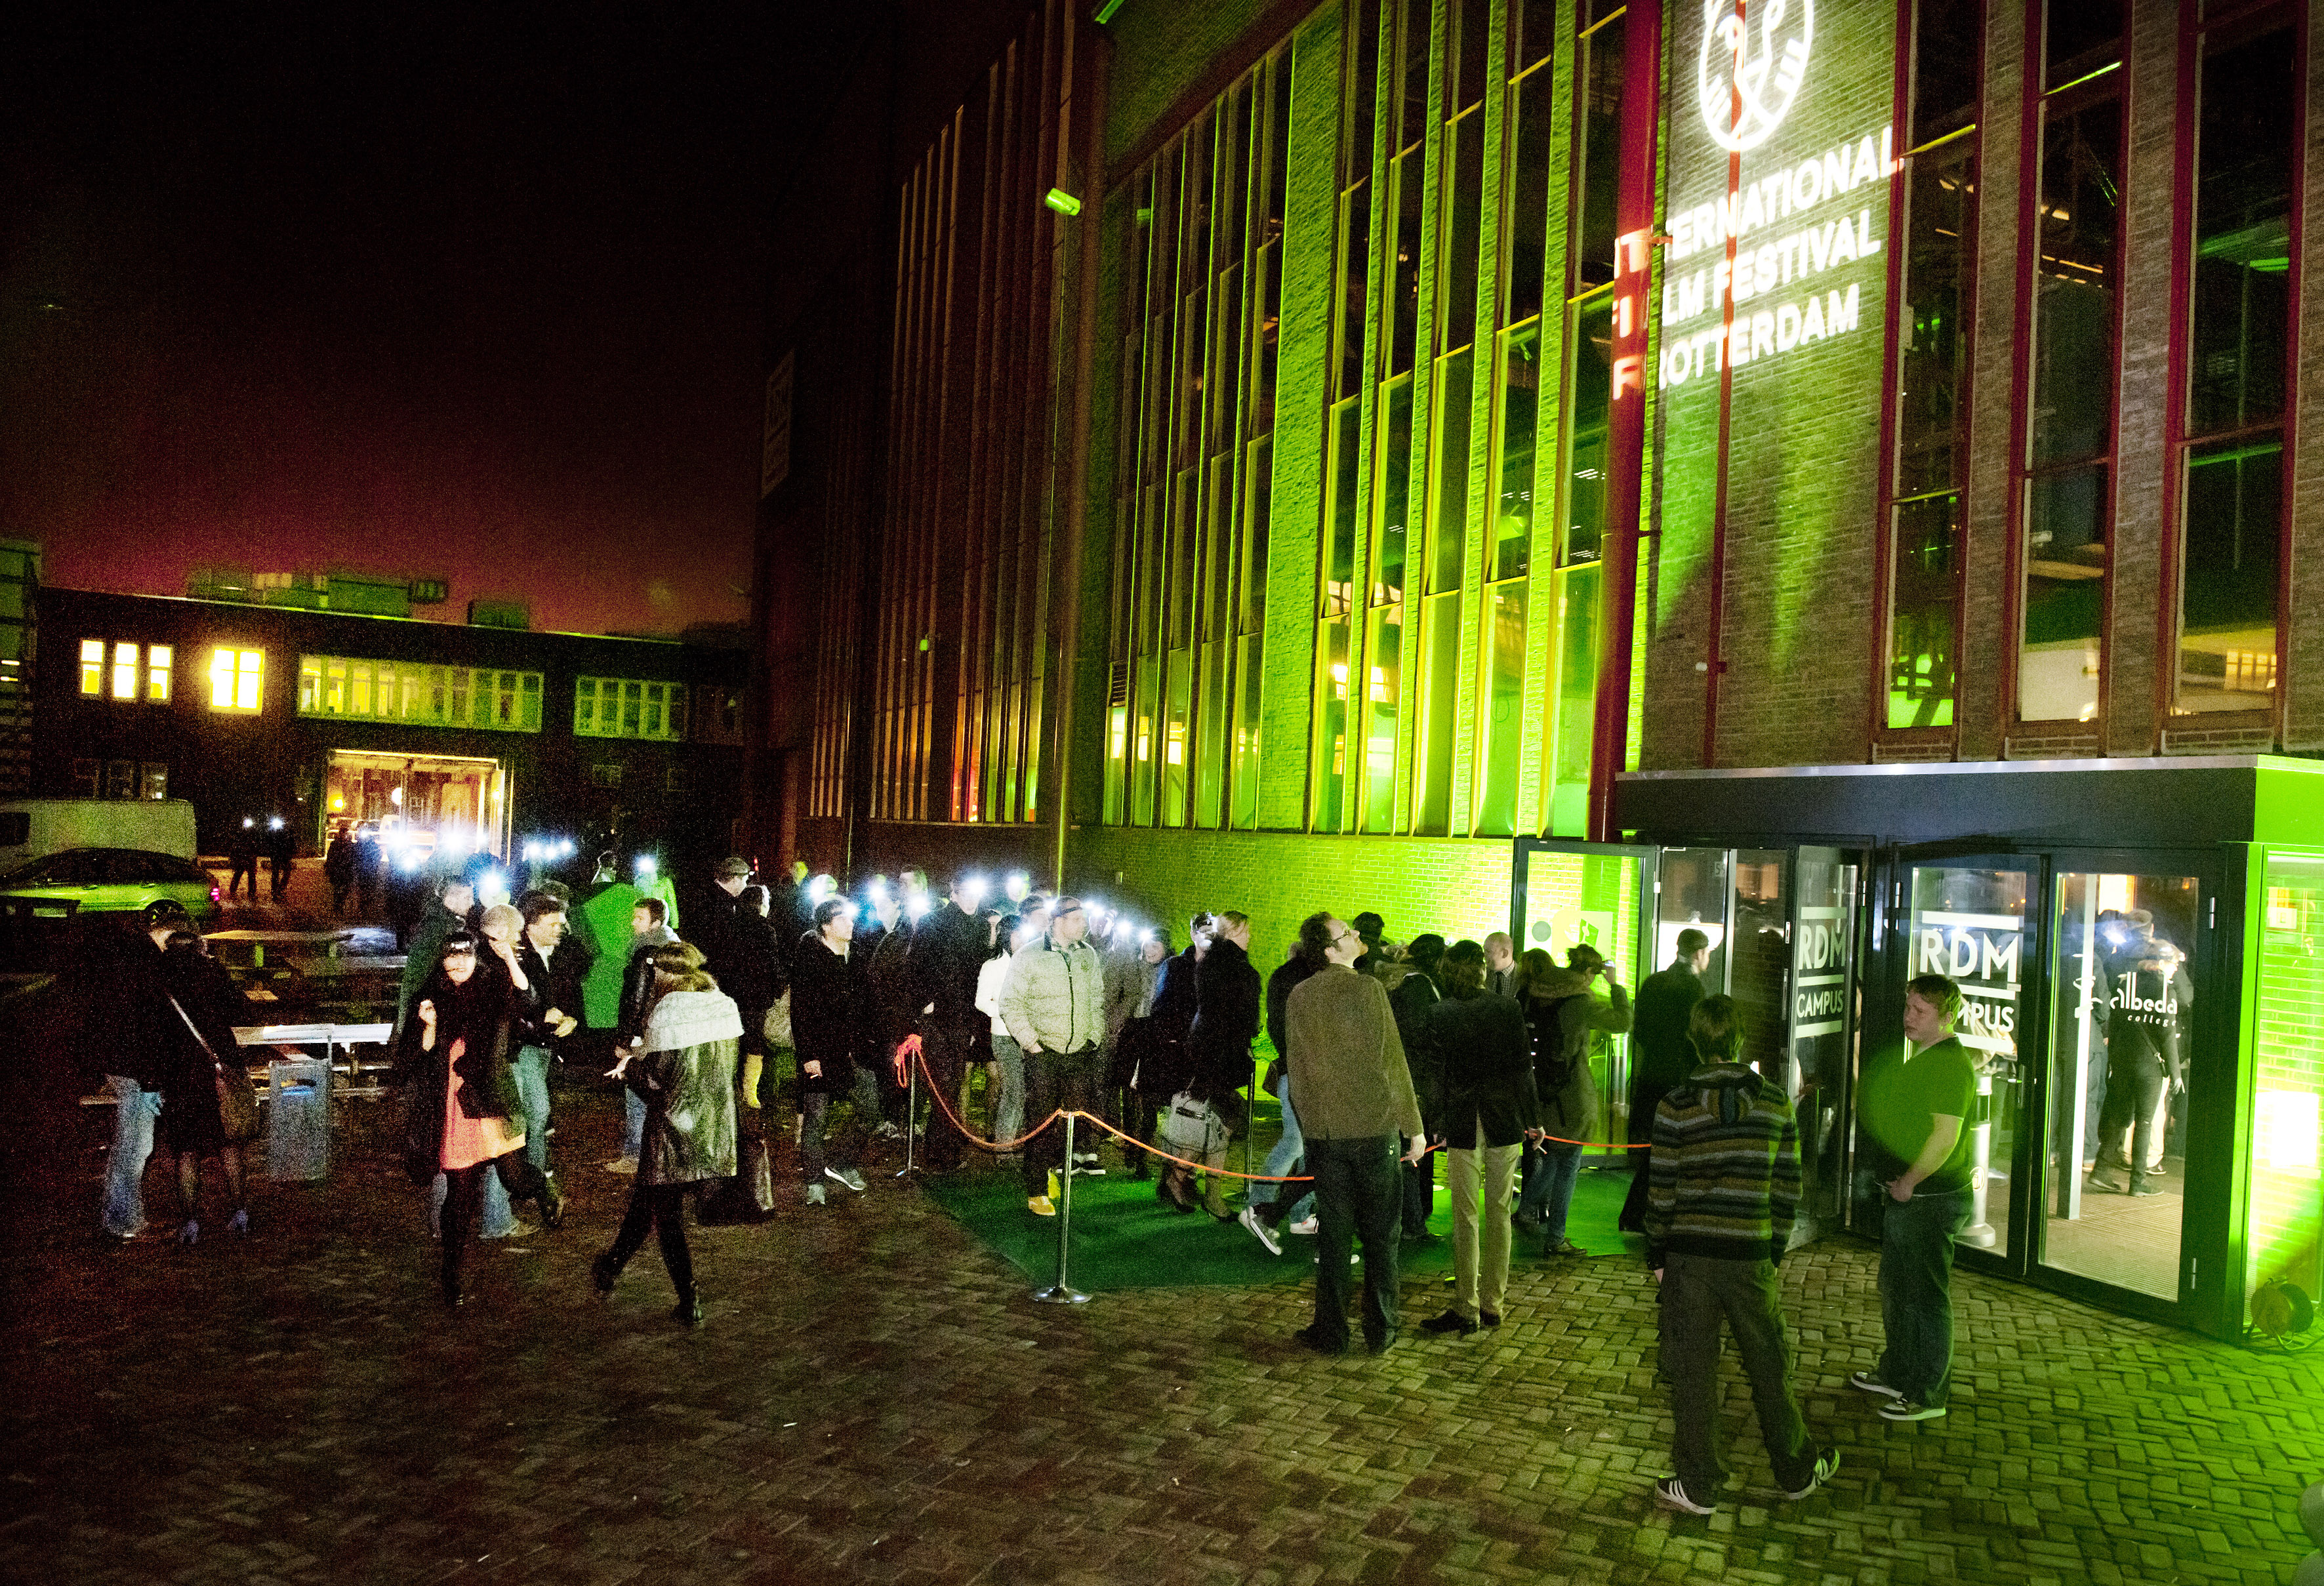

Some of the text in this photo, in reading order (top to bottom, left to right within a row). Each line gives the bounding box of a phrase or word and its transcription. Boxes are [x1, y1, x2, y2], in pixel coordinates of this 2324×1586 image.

[1614, 125, 1904, 279] TERNATIONAL
[1713, 209, 1881, 309] FESTIVAL
[1799, 925, 1847, 969] RDM
[1920, 929, 2018, 983] RDM
[1797, 989, 1843, 1018] CAMPUS
[2110, 971, 2178, 1014] albeda
[1958, 1002, 2014, 1032] MPUS
[2127, 1015, 2176, 1027] college
